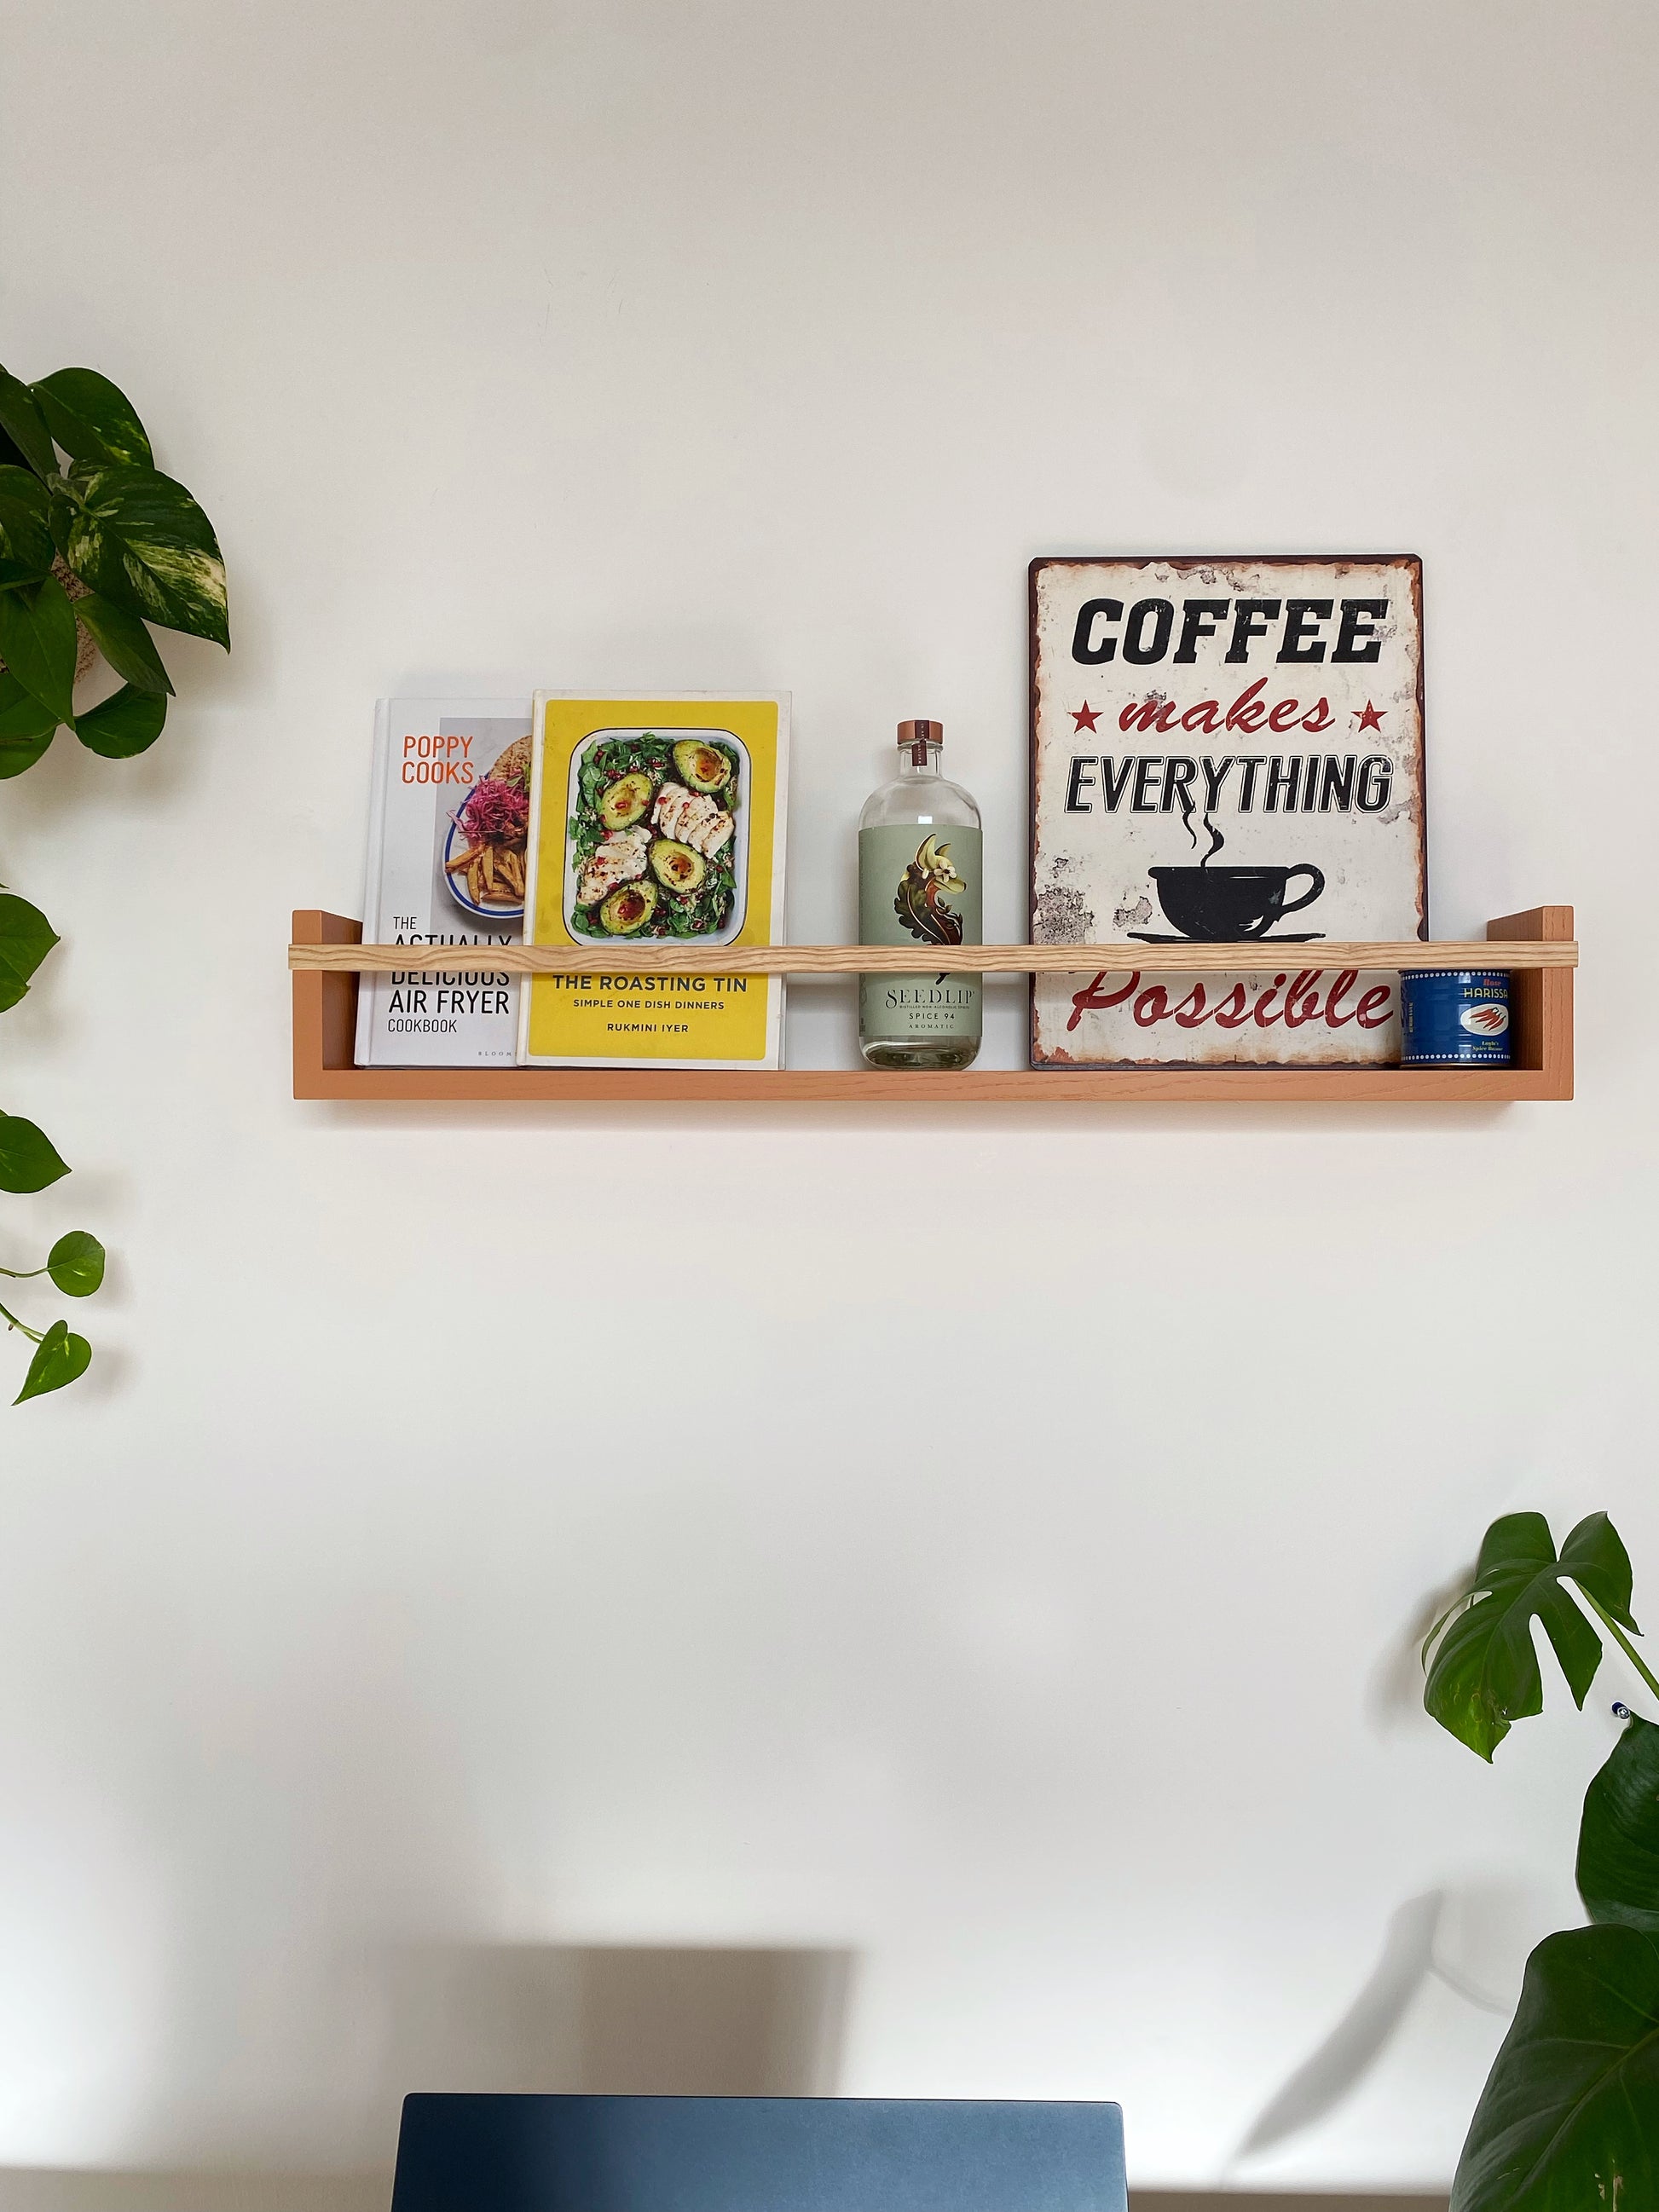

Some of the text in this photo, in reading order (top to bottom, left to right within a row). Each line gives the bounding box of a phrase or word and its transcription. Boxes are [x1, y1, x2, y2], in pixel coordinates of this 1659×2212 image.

[1071, 598, 1390, 665] COFFEE
[1119, 676, 1336, 734] makes
[403, 736, 473, 758] POPPY
[402, 761, 474, 784] COOKS
[1064, 754, 1394, 815] EVERYTHING
[393, 916, 418, 930] THE
[552, 974, 747, 992] THE ROASTING TIN
[1464, 987, 1508, 999] HARISSA
[389, 989, 510, 1014] AIR FRYER
[573, 999, 725, 1010] SIMPLE ONE DISH DINNERS
[885, 989, 972, 1009] SEEDLIP
[1066, 969, 1394, 1031] Possible
[388, 1019, 458, 1033] COOKBOOK
[607, 1023, 689, 1033] RUKMINI IYER
